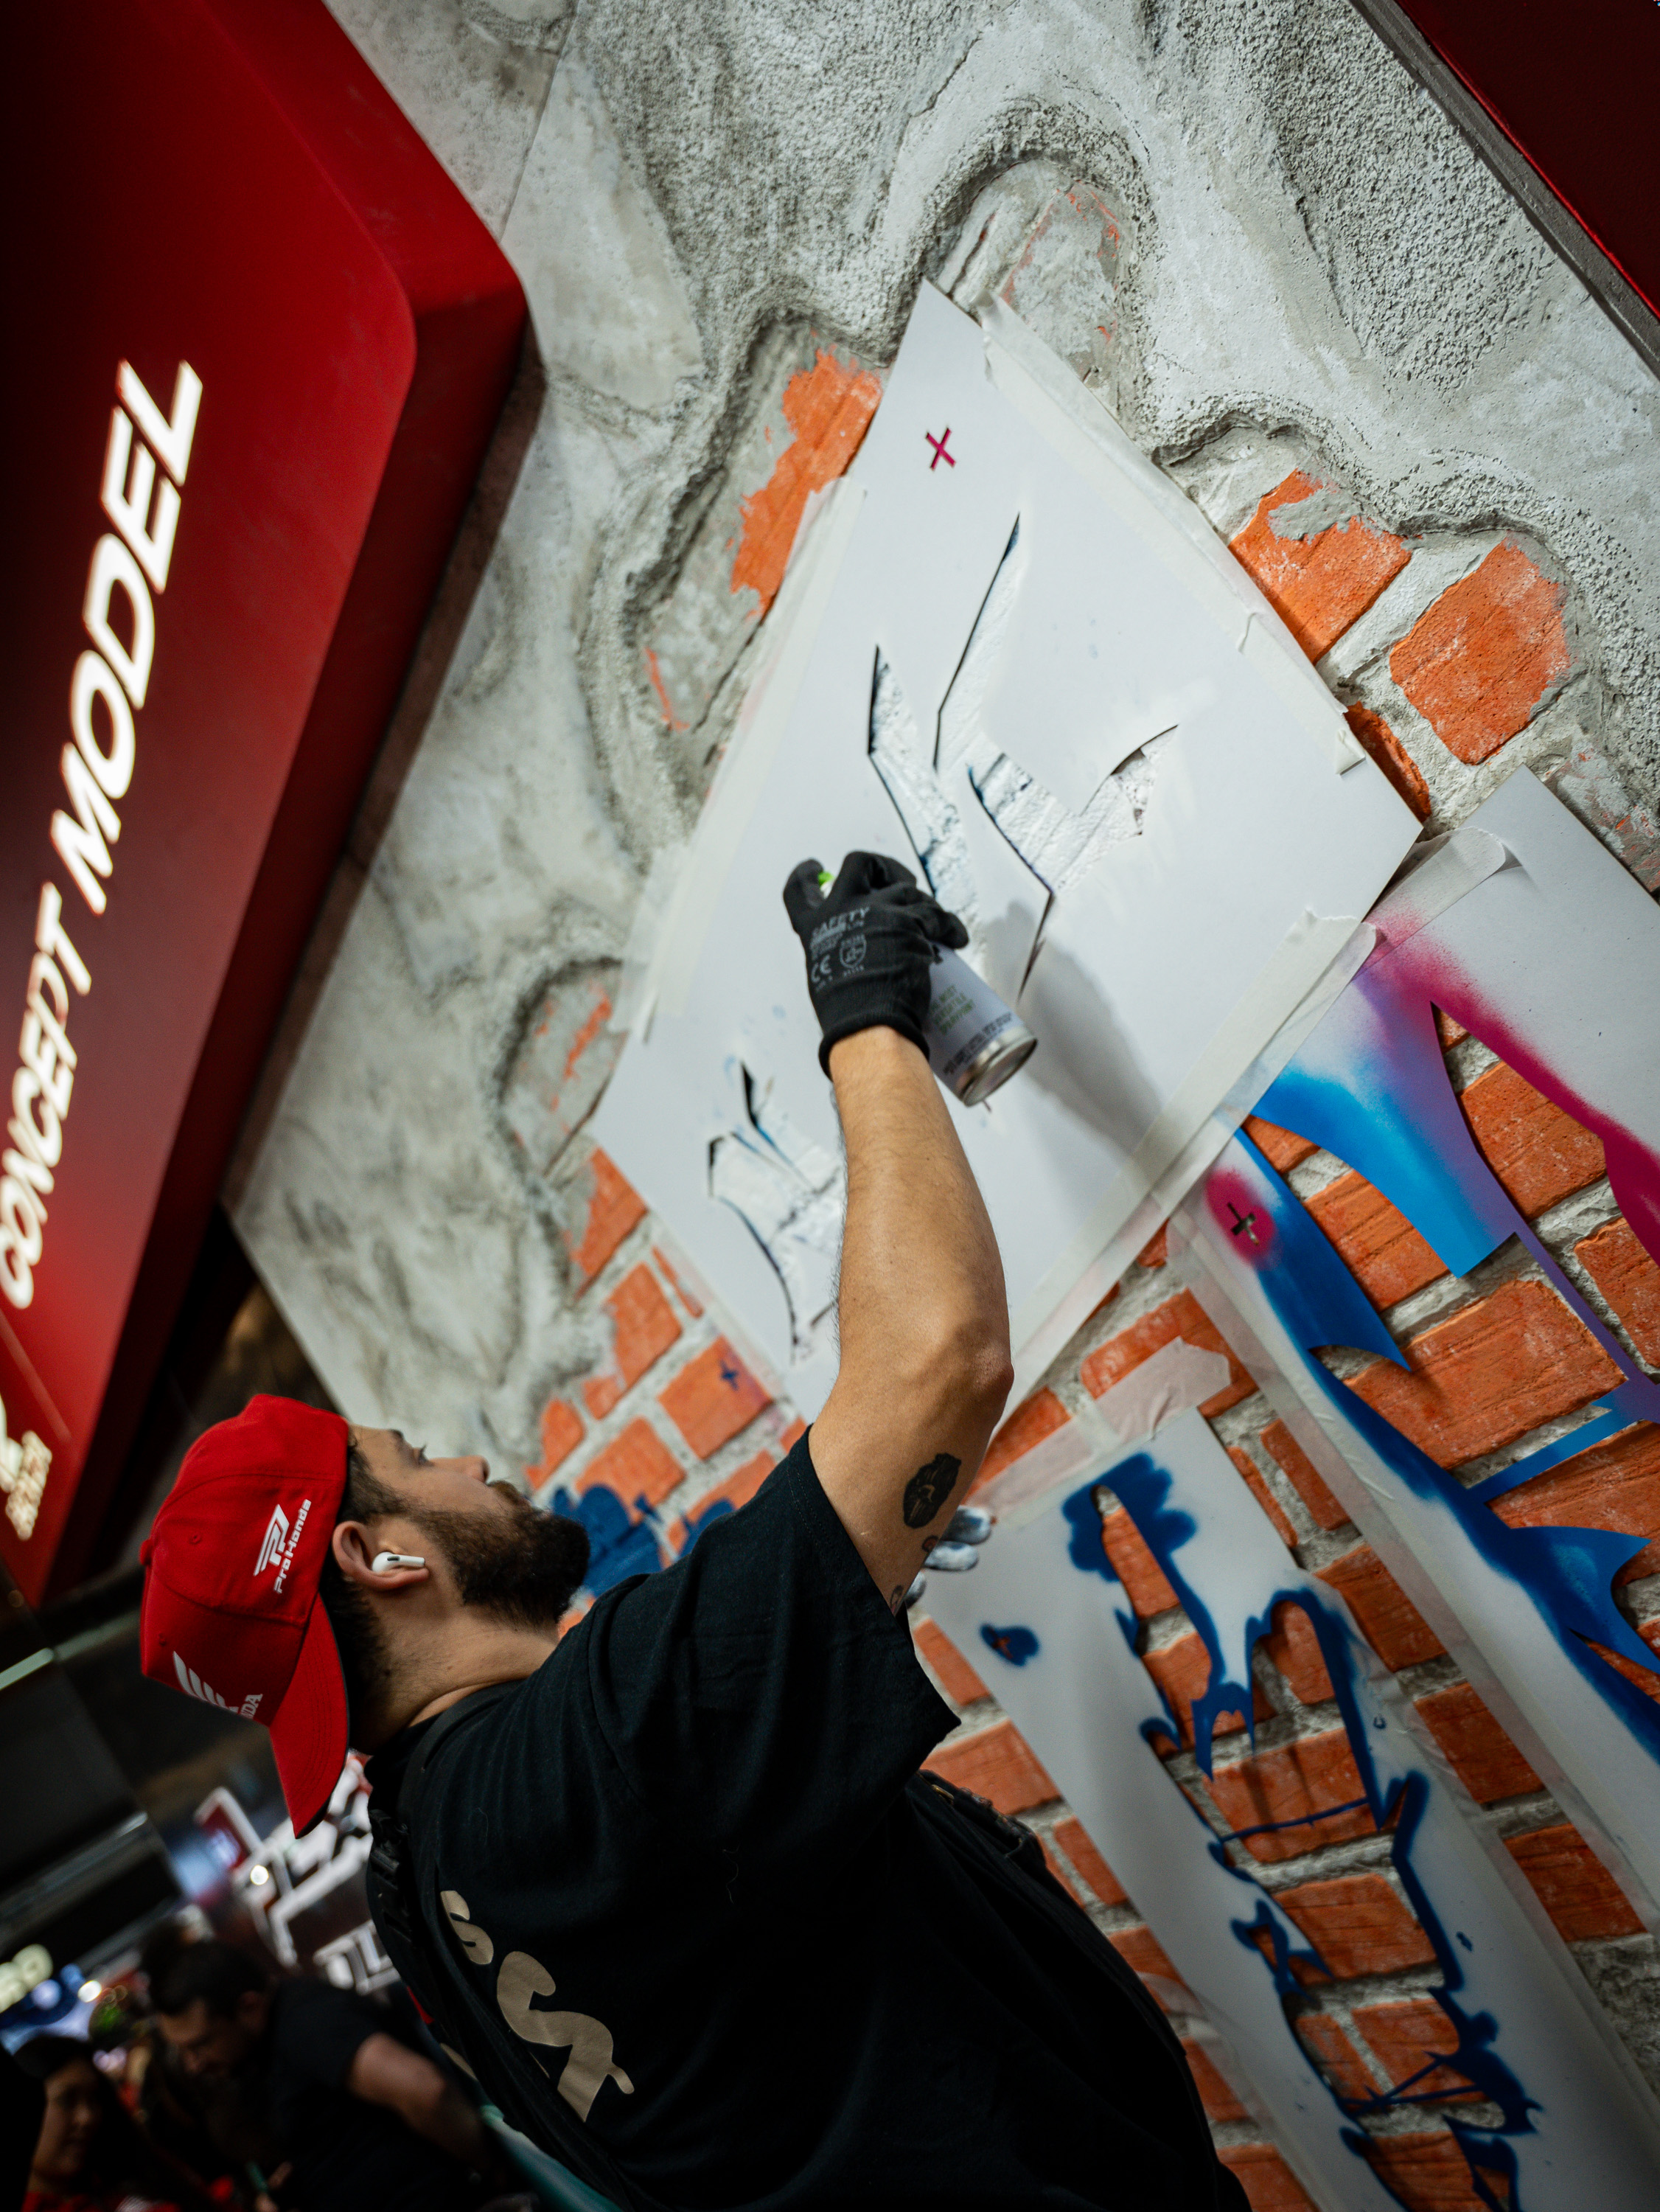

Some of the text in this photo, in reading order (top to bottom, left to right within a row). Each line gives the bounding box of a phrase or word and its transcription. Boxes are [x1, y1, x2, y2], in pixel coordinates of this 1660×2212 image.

[0, 358, 203, 1309] CONCEPT MODEL
[240, 1694, 263, 1719] NDA
